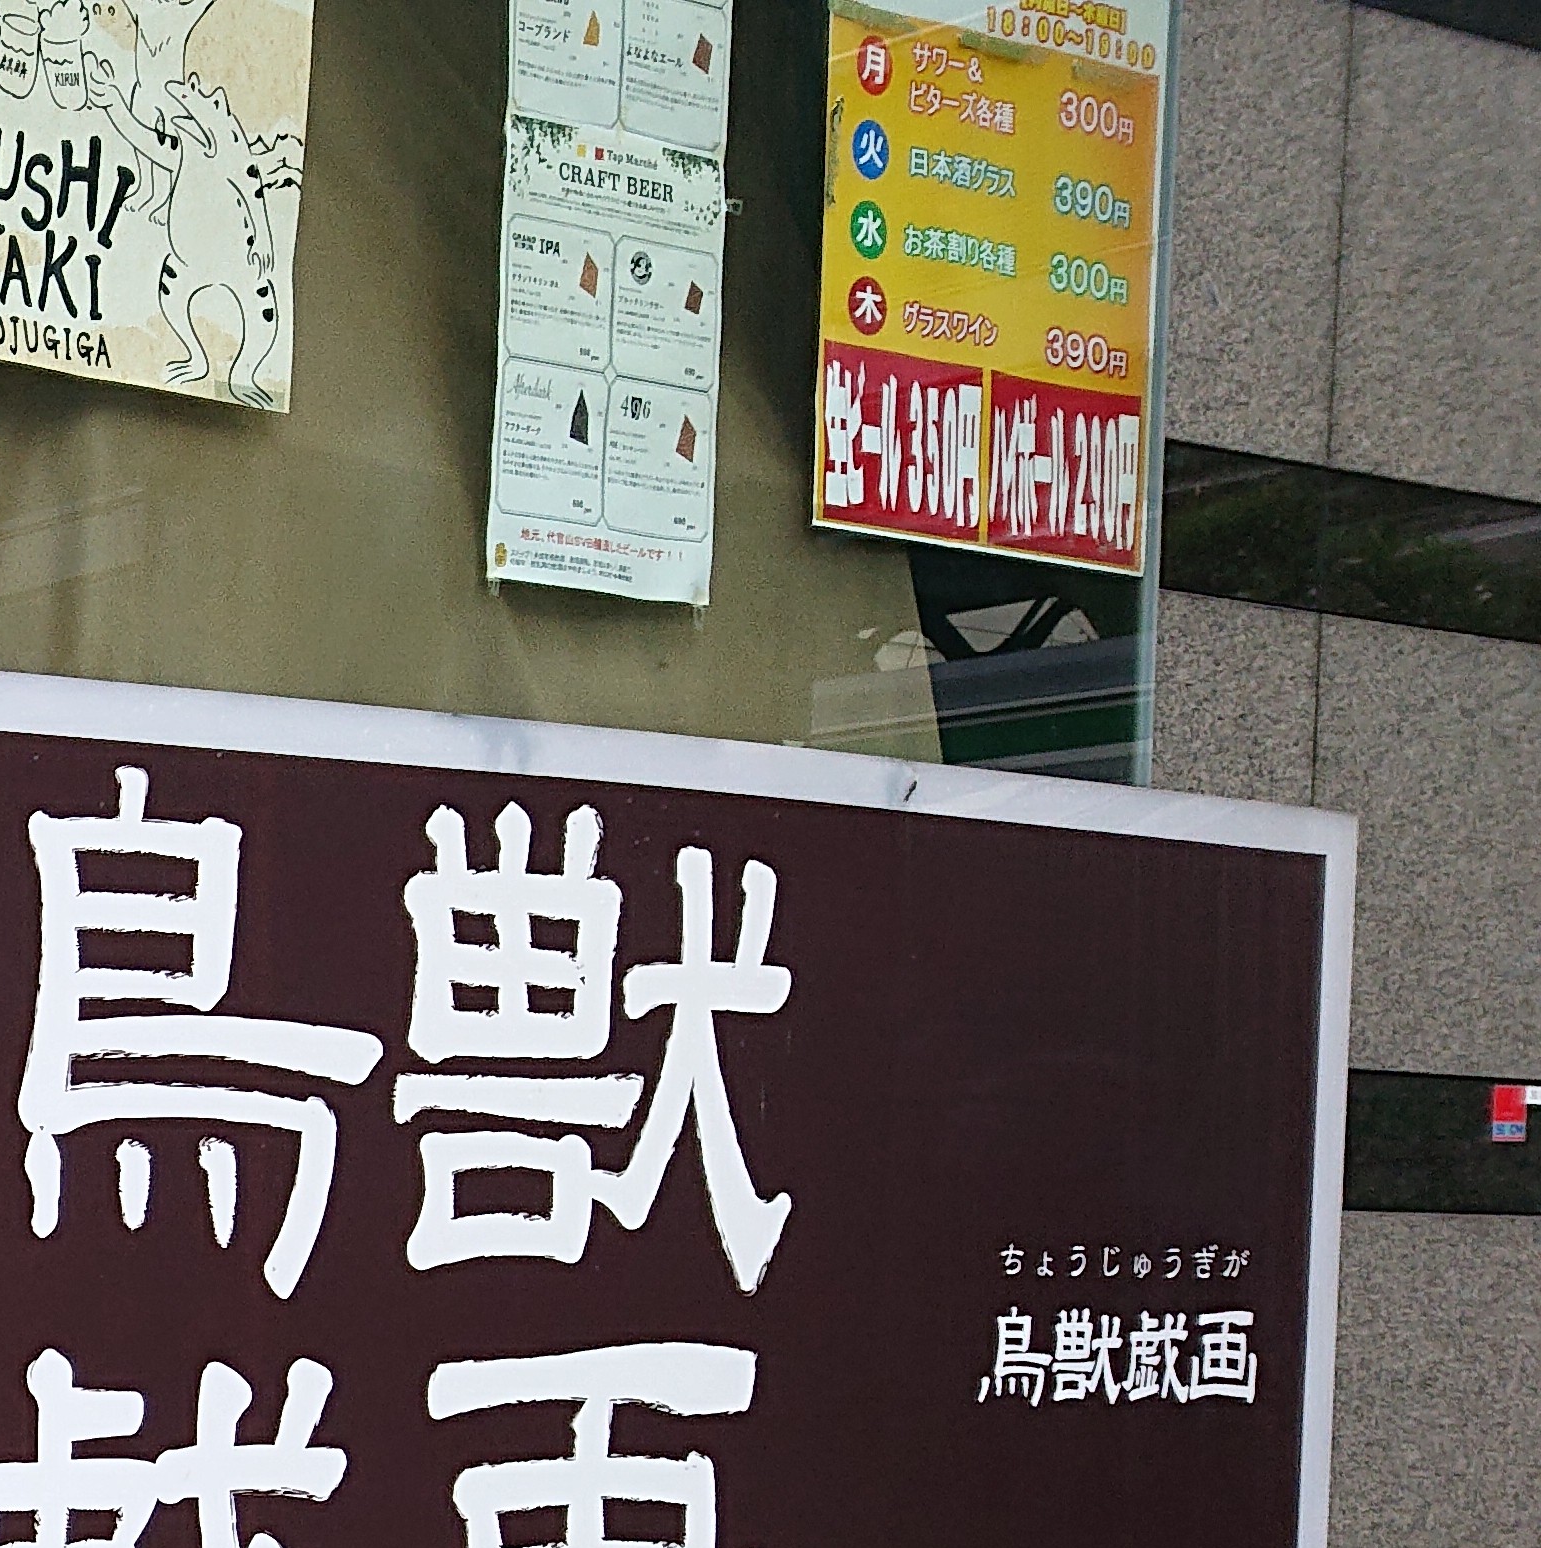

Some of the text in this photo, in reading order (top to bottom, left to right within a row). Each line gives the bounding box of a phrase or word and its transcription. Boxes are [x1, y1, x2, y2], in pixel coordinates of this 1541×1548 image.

[860, 45, 886, 86] 月
[907, 80, 1016, 135] ビターズ各種
[1058, 90, 1135, 146] 300円
[606, 149, 624, 165] Tap
[858, 130, 885, 169] 火
[908, 147, 1017, 198] 日本酒グラス
[558, 162, 675, 203] CRAFT BEER
[1053, 174, 1132, 229] 390円
[538, 238, 561, 258] IPA
[856, 210, 884, 248] 水
[902, 224, 1017, 278] お茶割り各種
[1048, 252, 1129, 305] 300円
[853, 285, 884, 324] 木
[902, 301, 999, 346] グラスワイン
[1045, 326, 1128, 378] 390円
[620, 395, 652, 421] 496
[825, 359, 983, 528] 生ビール350円
[988, 393, 1141, 550] ハイボール290円
[999, 1242, 1251, 1279] ちょうじゅうぎが
[976, 1306, 1258, 1407] 鳥獣戯画
